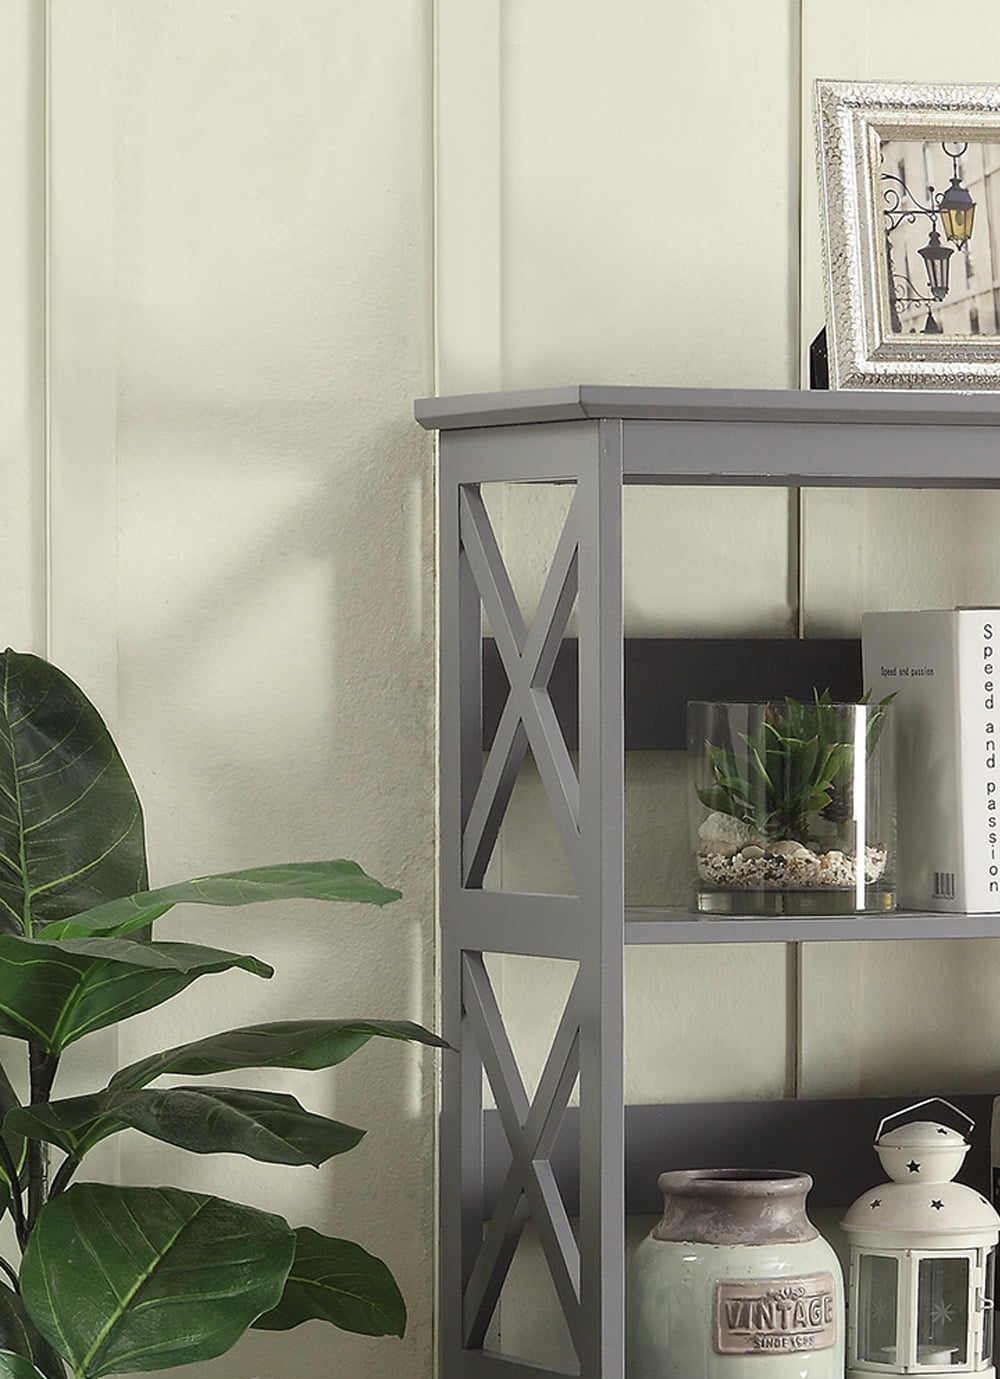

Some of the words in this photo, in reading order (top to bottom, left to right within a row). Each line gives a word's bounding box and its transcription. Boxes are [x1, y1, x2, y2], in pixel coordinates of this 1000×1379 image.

[983, 623, 995, 709] Speed
[985, 722, 996, 768] and
[986, 781, 999, 892] passion
[724, 1296, 833, 1330] VINTAGE
